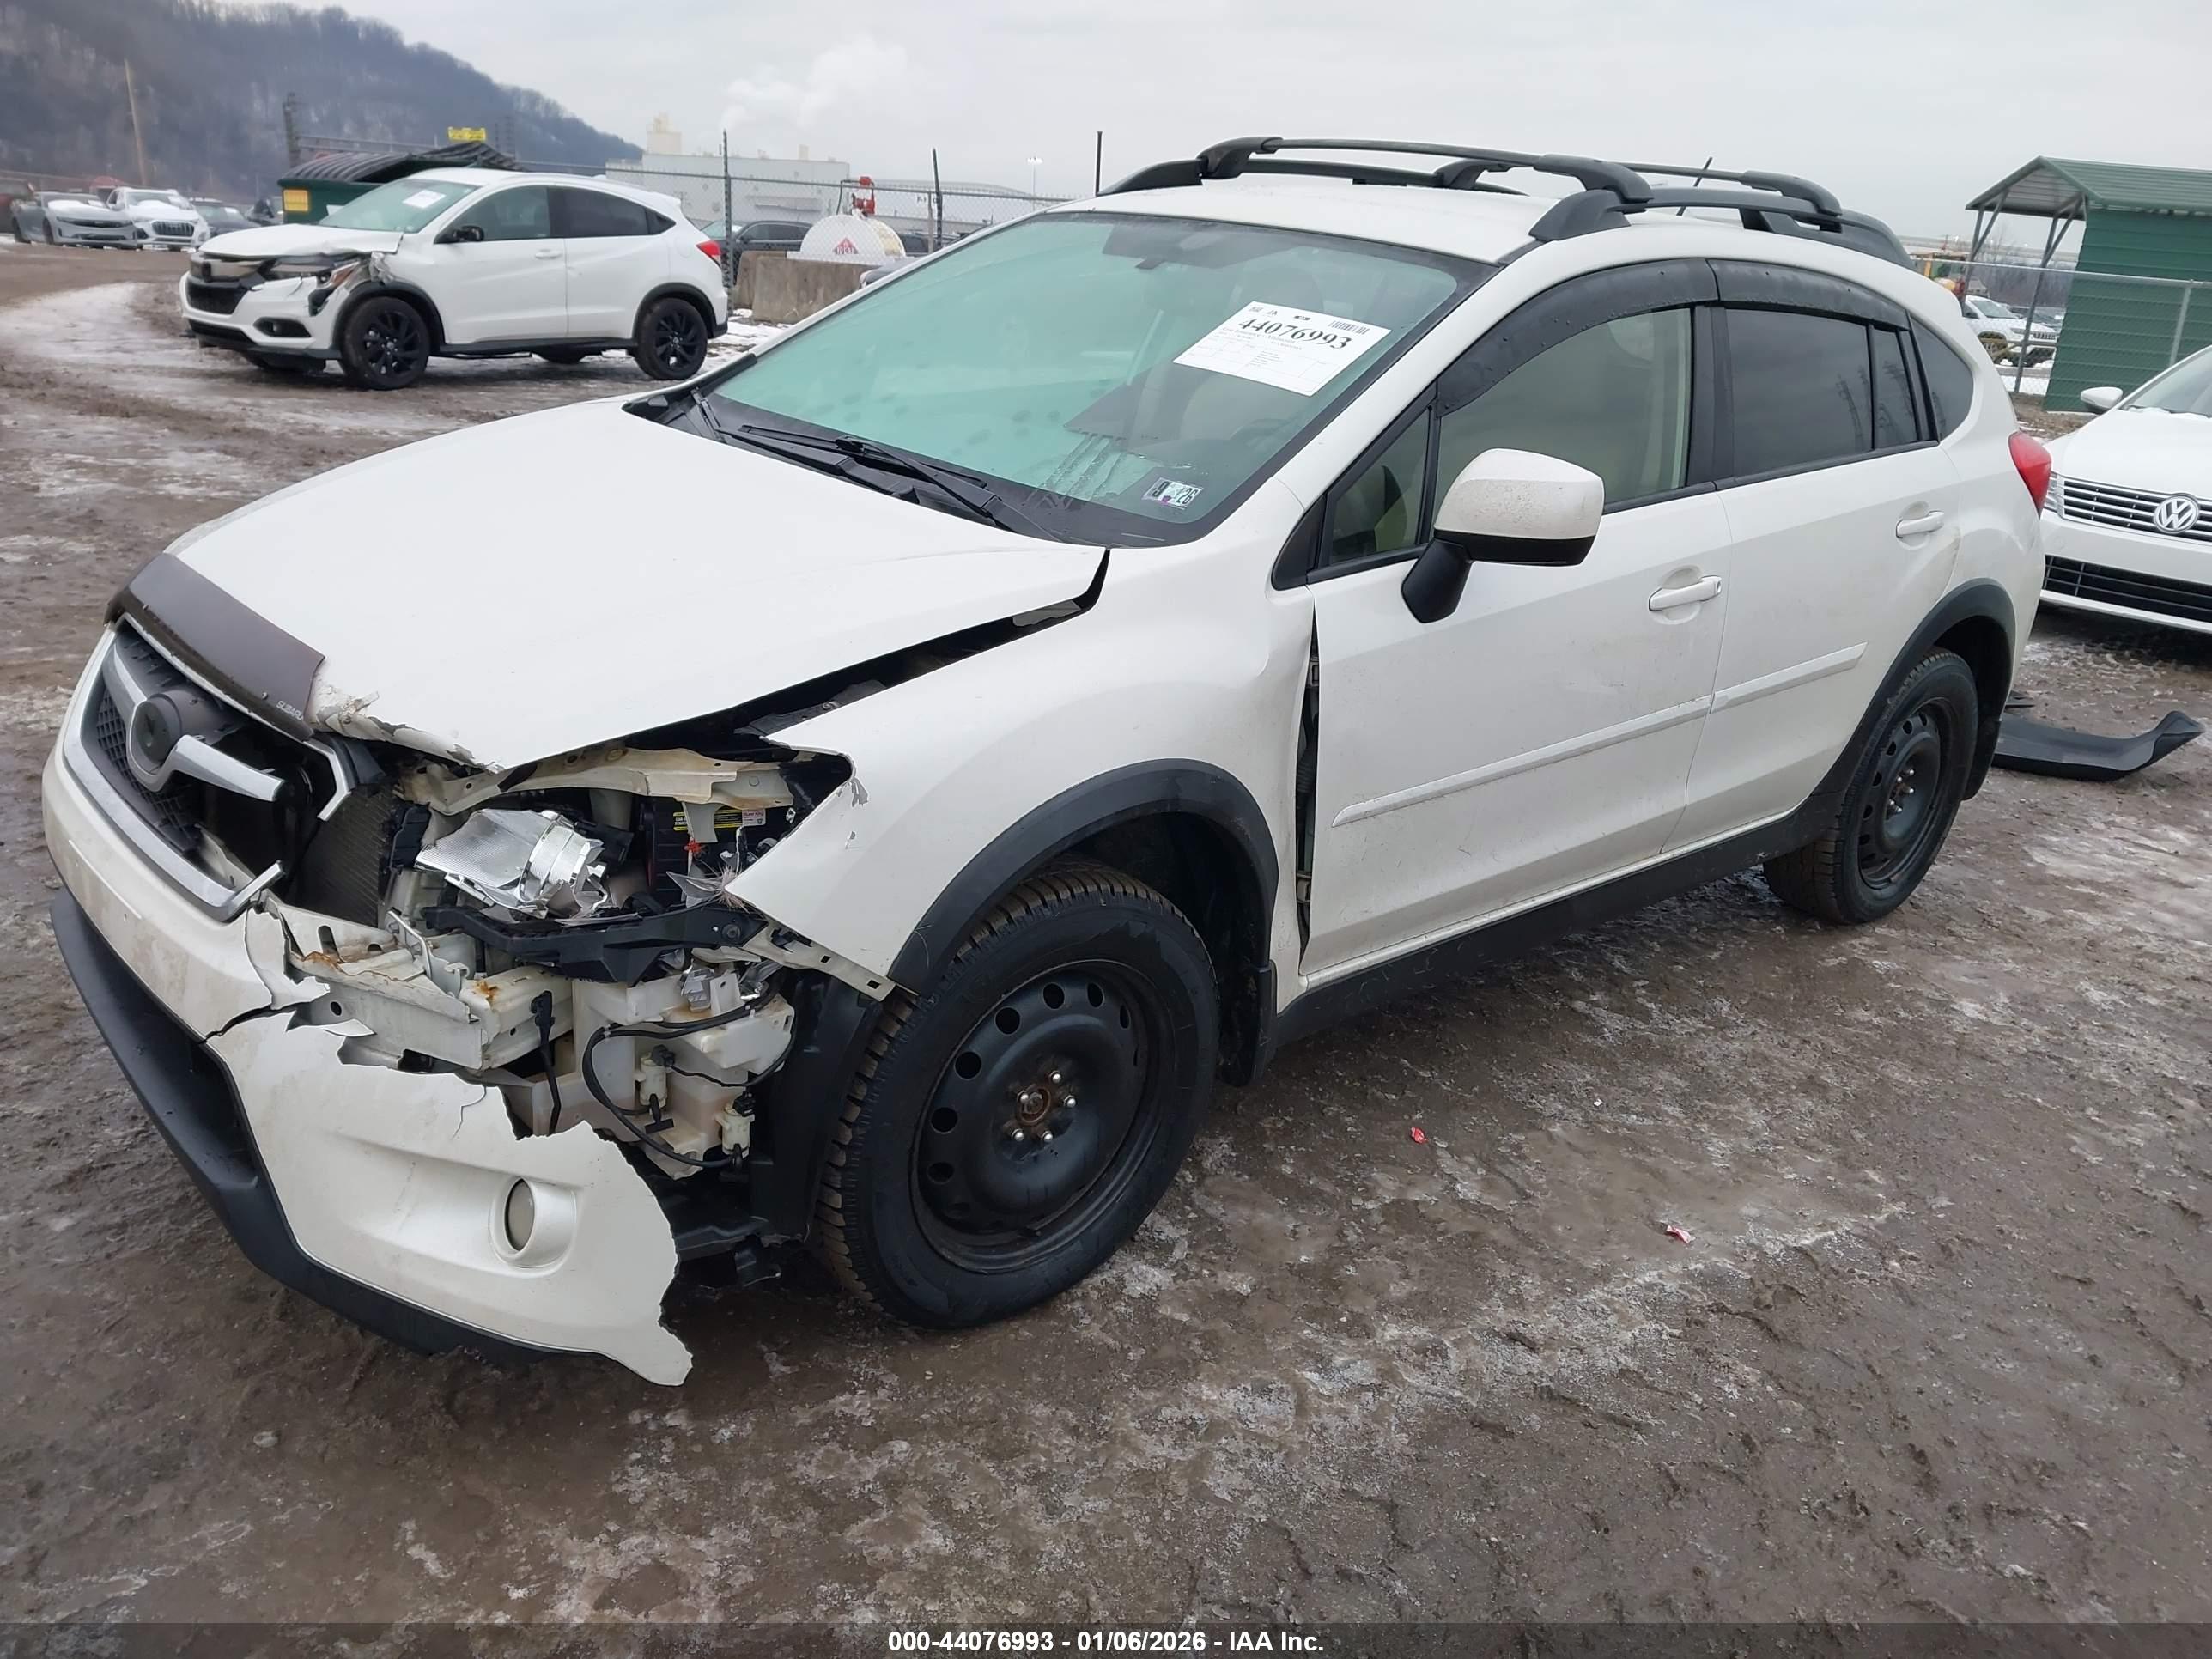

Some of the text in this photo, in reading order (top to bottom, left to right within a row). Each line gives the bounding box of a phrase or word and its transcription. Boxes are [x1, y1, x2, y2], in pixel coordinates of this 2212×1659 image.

[1238, 319, 1352, 349] 44076993
[1176, 487, 1199, 505] 26
[276, 700, 304, 720] SUBARU
